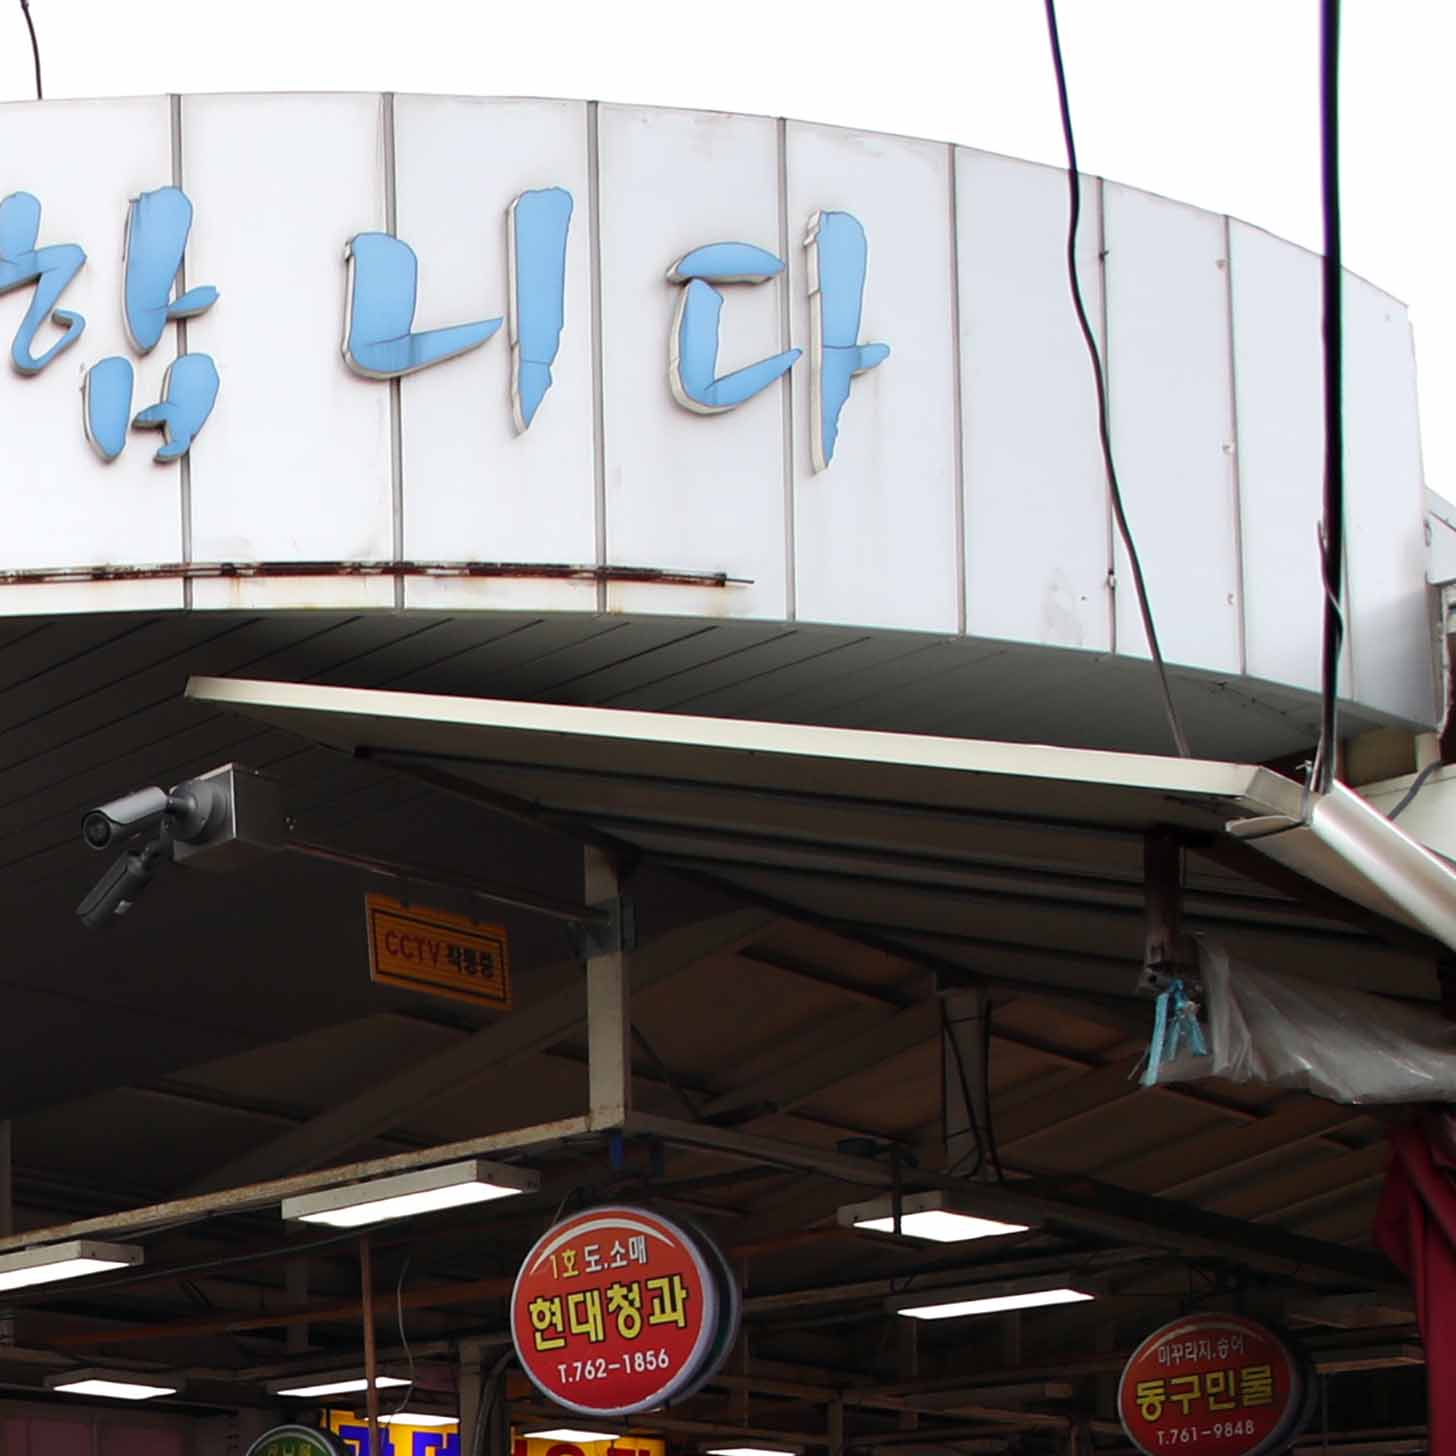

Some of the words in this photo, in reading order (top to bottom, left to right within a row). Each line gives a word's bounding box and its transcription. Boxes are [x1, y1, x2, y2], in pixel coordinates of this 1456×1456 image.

[550, 1248, 580, 1279] 1호
[528, 1274, 688, 1352] 현대청과
[557, 1348, 670, 1383] T.762-1856
[1135, 1363, 1275, 1422] 동구민물
[1155, 1419, 1256, 1446] T.761-9848
